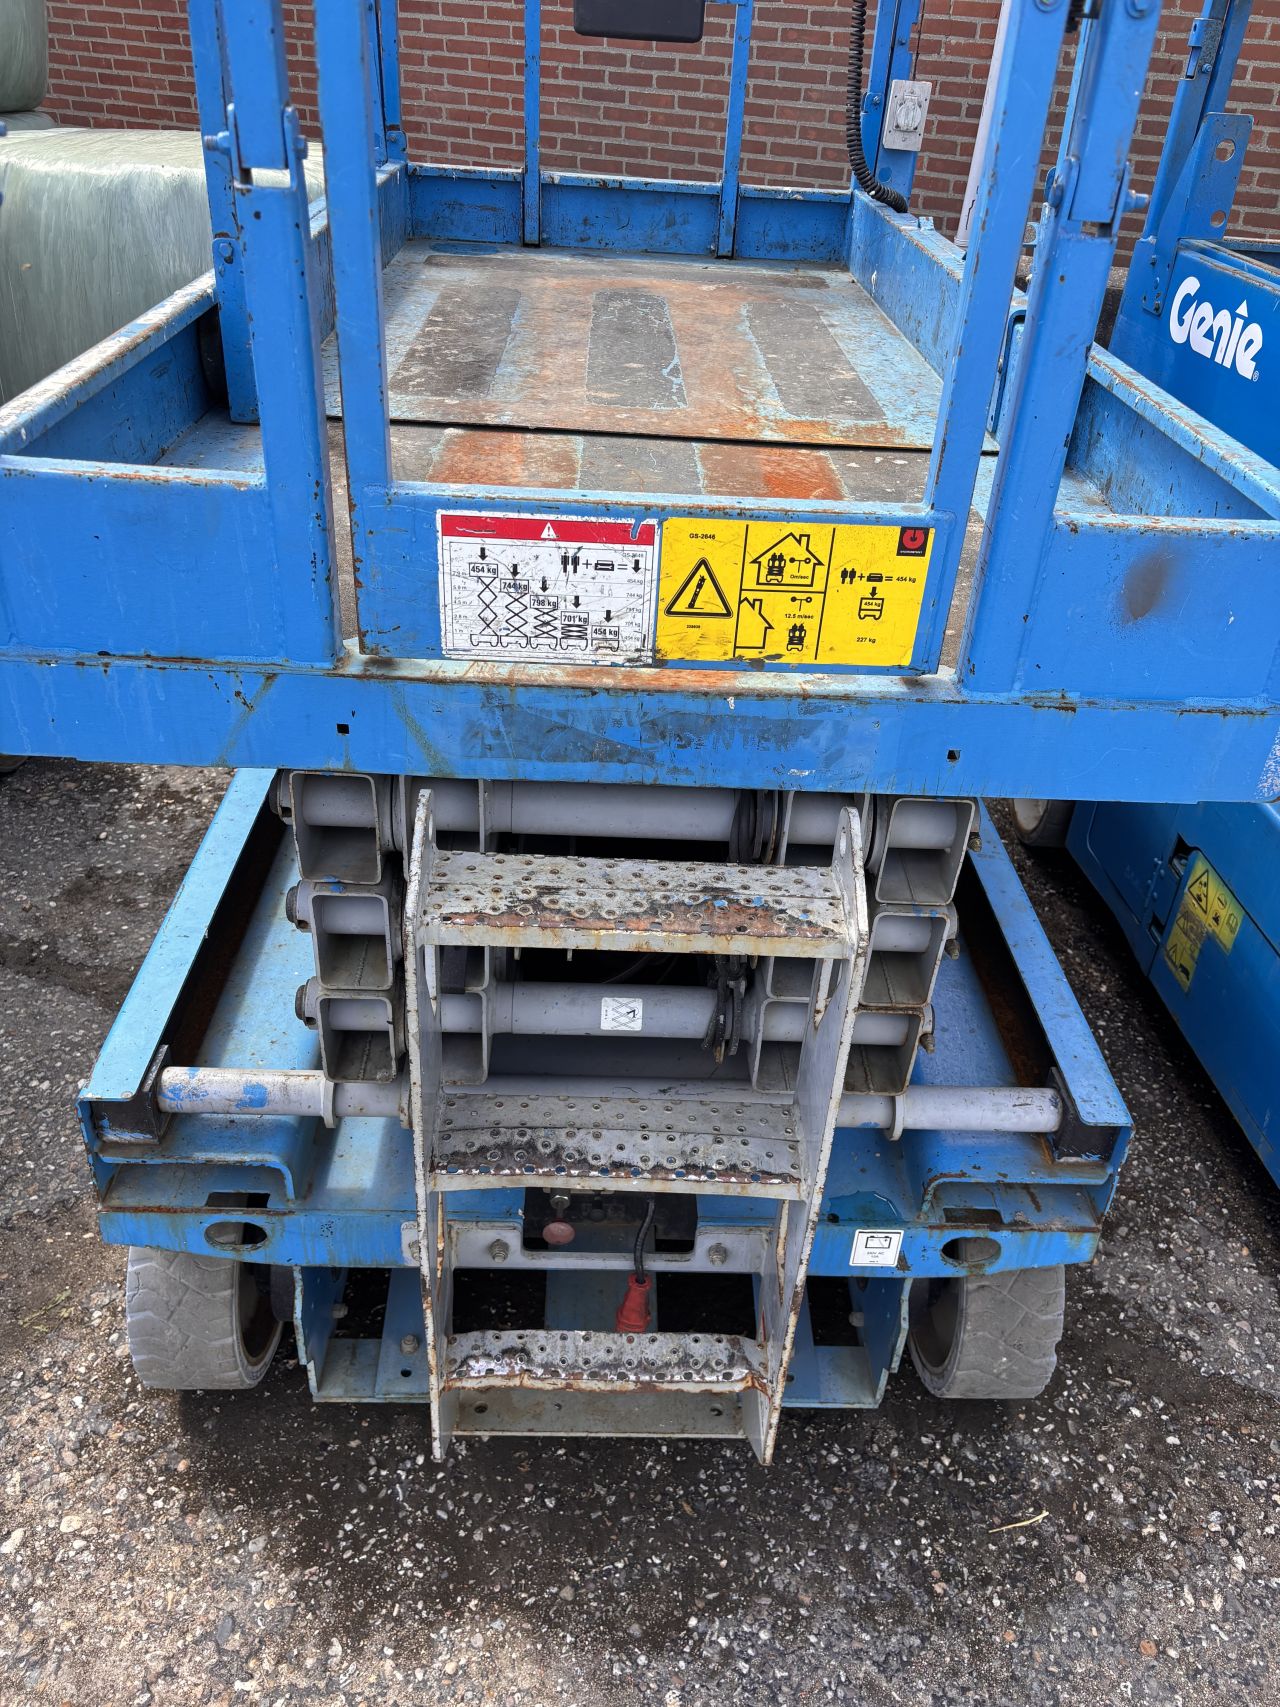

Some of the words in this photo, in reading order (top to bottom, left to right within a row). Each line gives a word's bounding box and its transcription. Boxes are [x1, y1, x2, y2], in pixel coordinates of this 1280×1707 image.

[1169, 276, 1263, 380] Genie
[470, 565, 485, 573] 454
[487, 566, 497, 575] kg
[518, 583, 528, 592] kg
[531, 598, 545, 606] 798
[547, 599, 557, 609] kg
[563, 614, 576, 623] 701
[578, 616, 588, 624] kg
[593, 628, 607, 636] 454
[608, 628, 618, 637] kg
